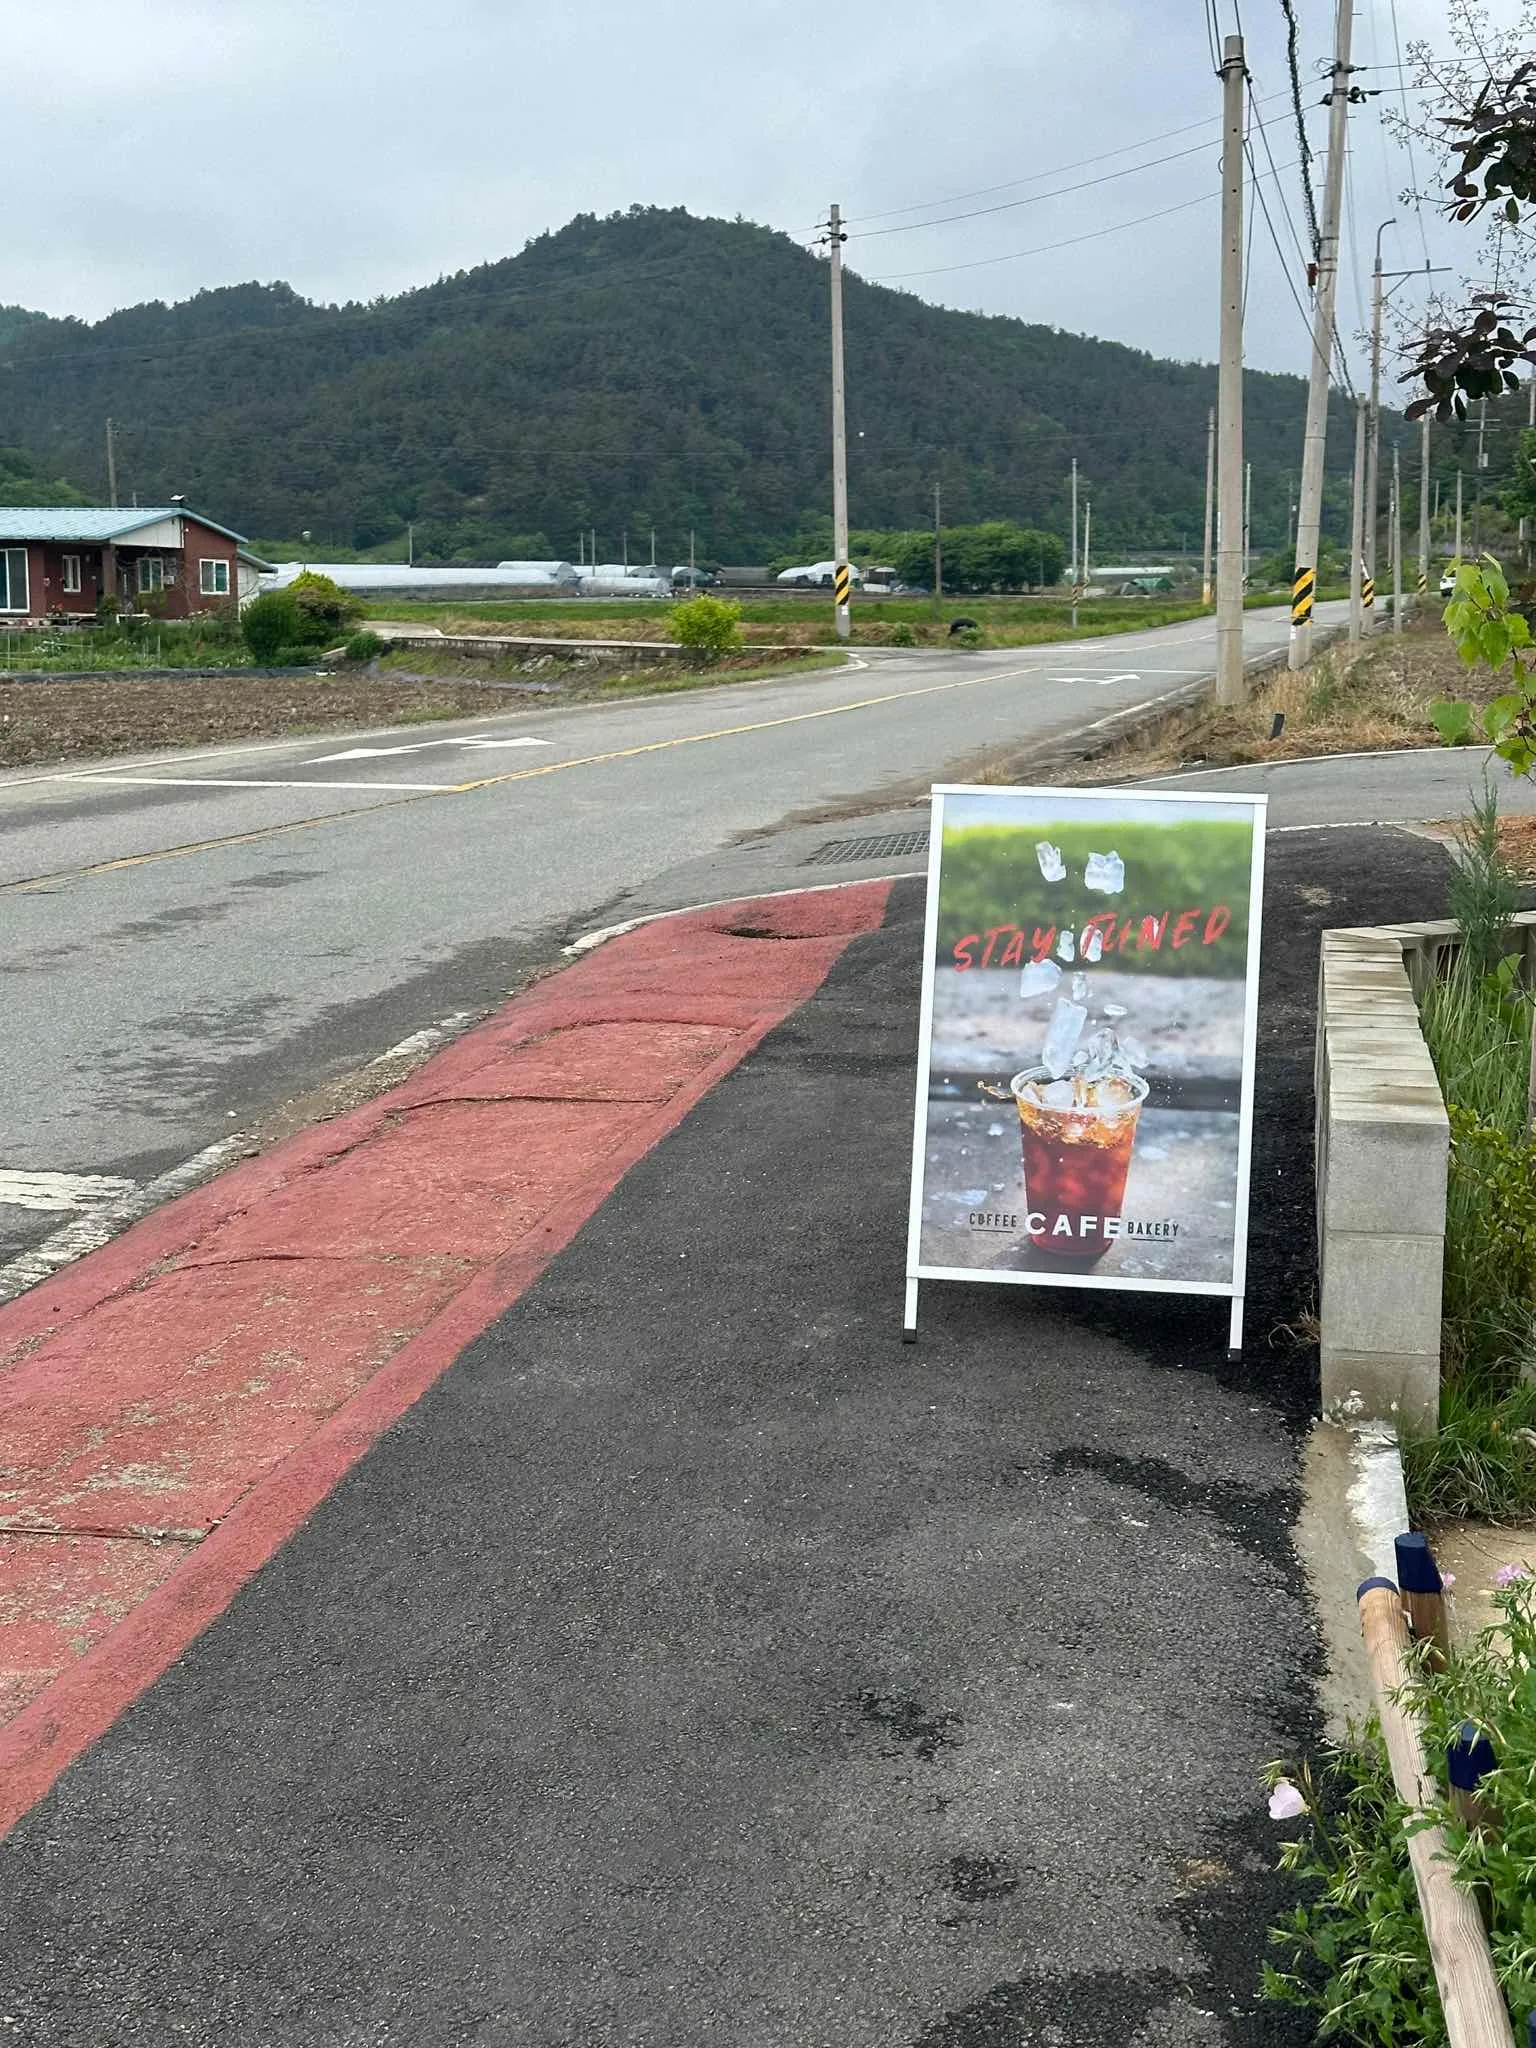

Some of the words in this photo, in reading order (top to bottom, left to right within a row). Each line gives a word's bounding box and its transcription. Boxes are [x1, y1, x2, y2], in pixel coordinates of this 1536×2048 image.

[952, 923, 1057, 973] STAY
[1081, 904, 1231, 960] TUNED
[969, 1212, 1018, 1227] COFFEE
[1024, 1212, 1121, 1239] CAFE
[1127, 1221, 1180, 1237] BAKERY
